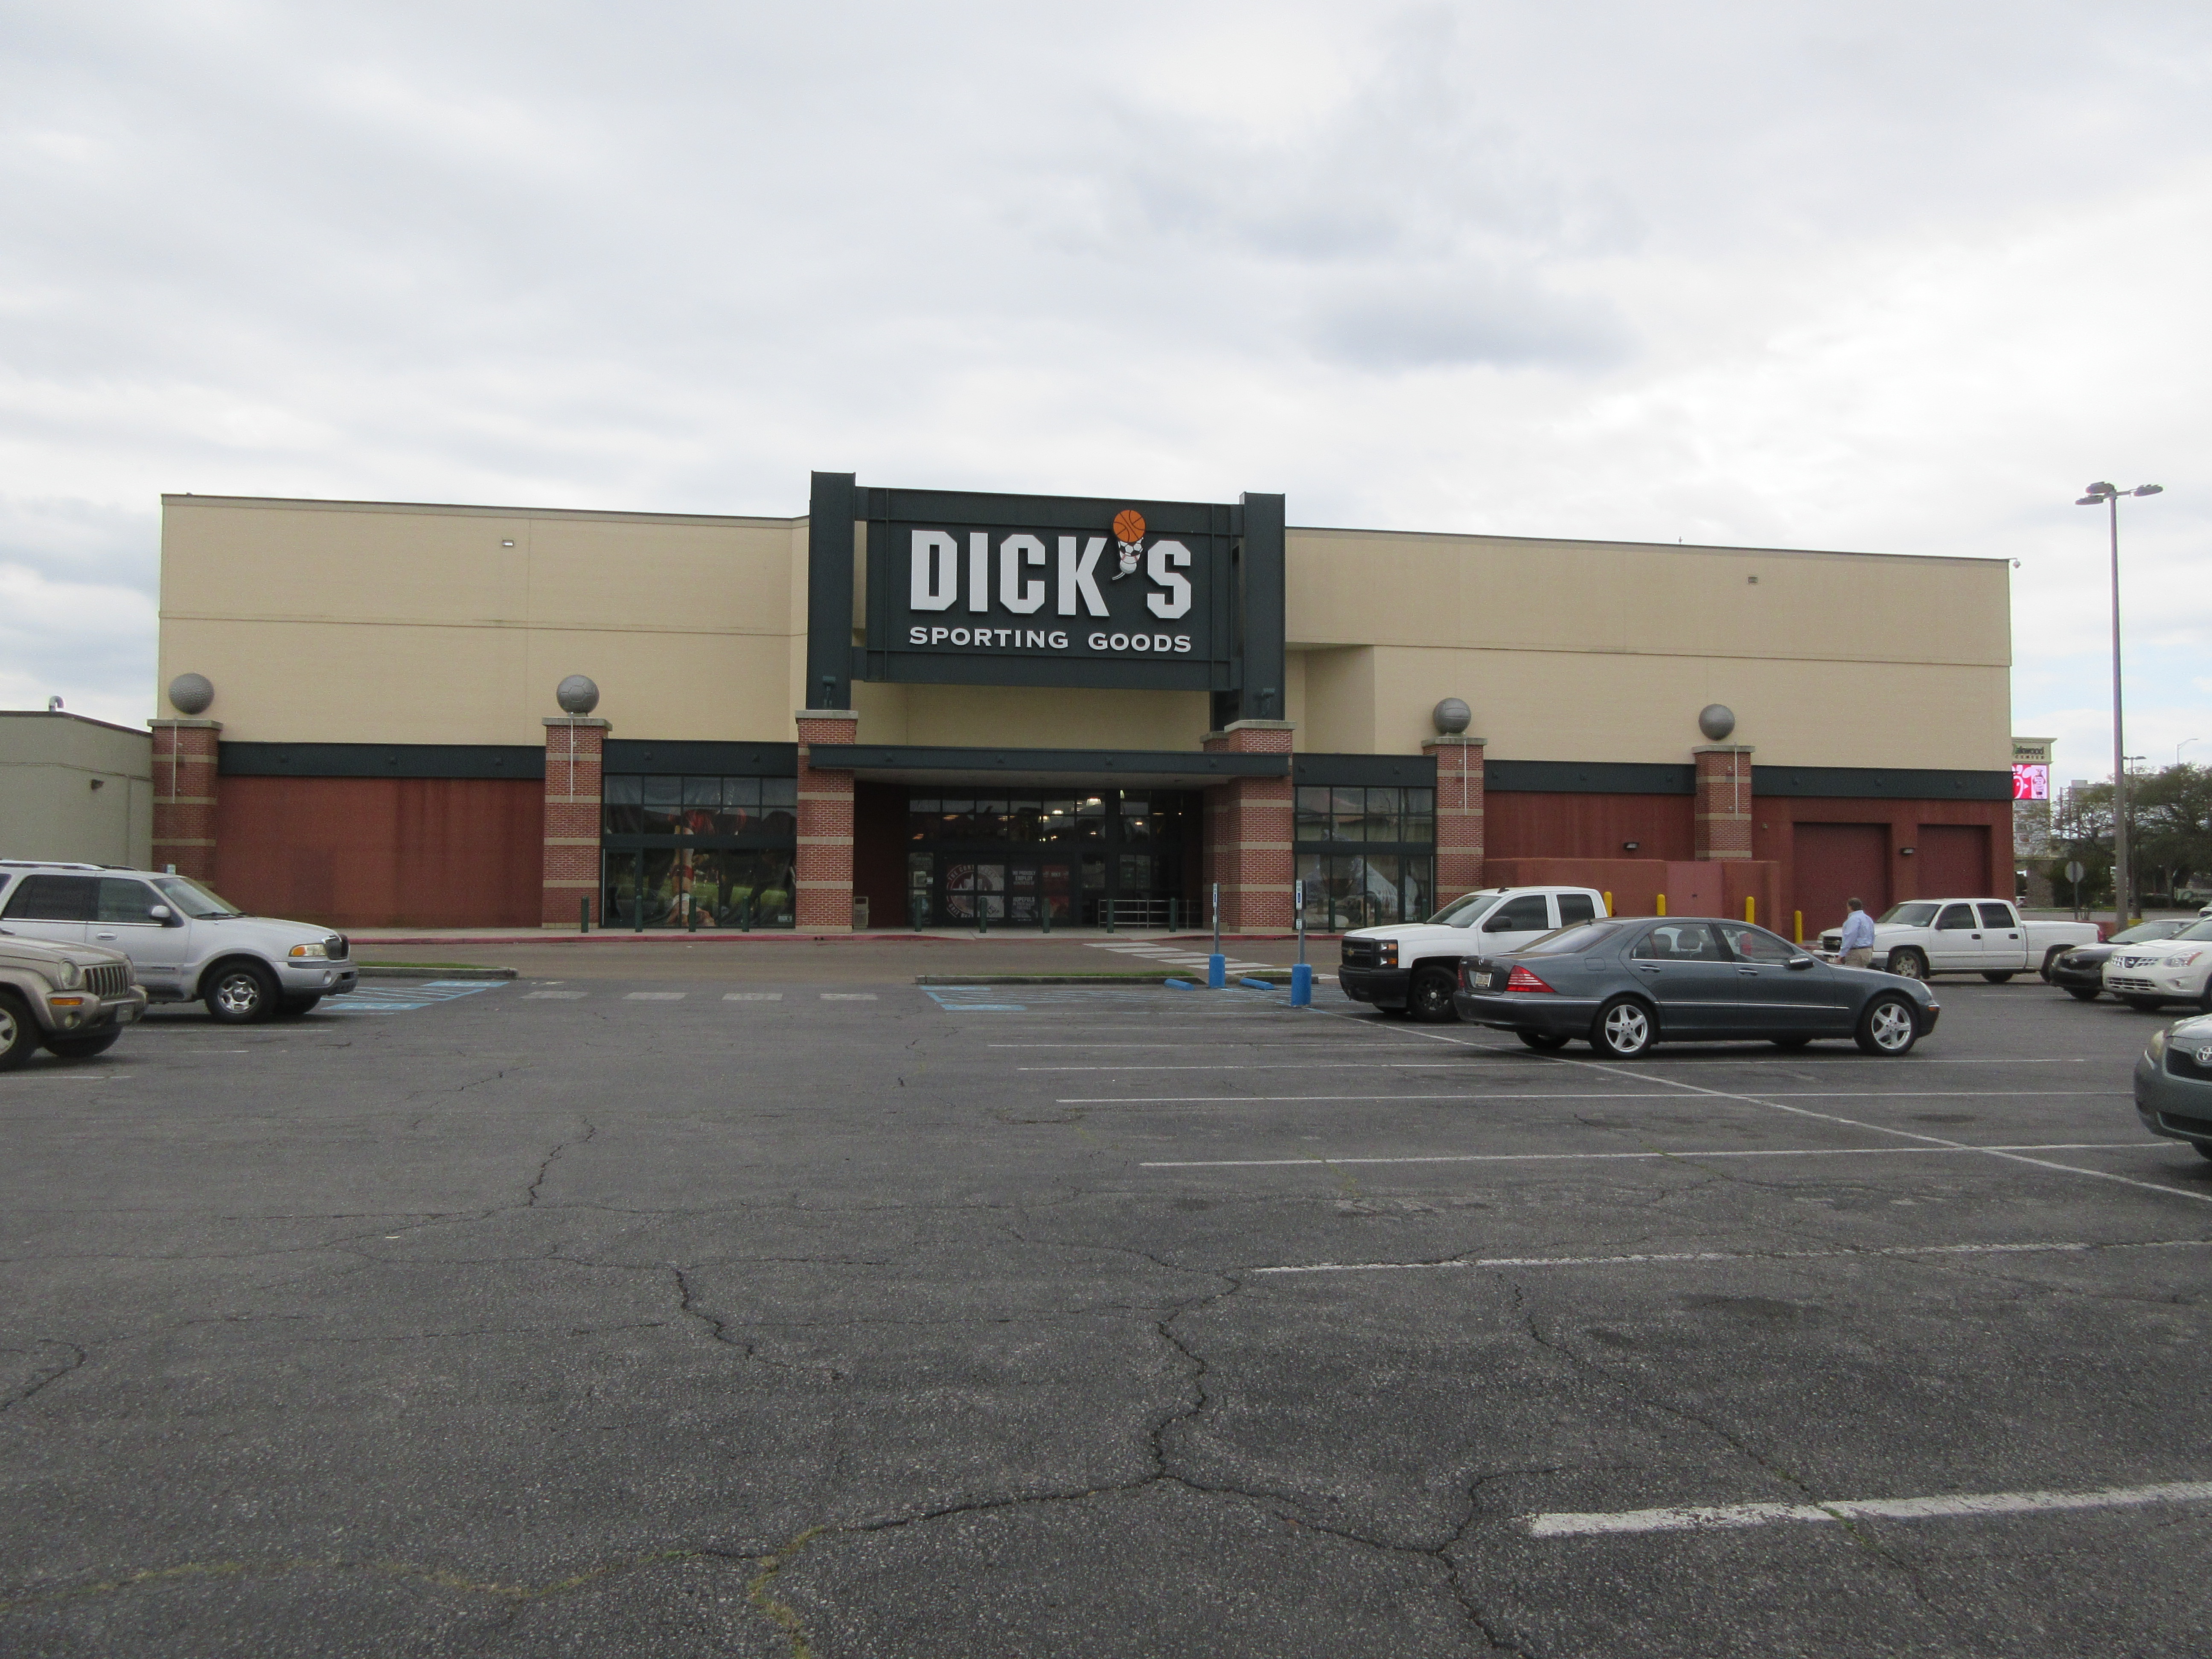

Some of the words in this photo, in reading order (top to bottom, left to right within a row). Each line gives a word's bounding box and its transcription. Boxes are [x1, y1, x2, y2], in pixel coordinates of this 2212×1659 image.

[911, 510, 1191, 619] DICK'S
[909, 626, 1068, 649] SPORTING
[1088, 632, 1192, 652] GOODS
